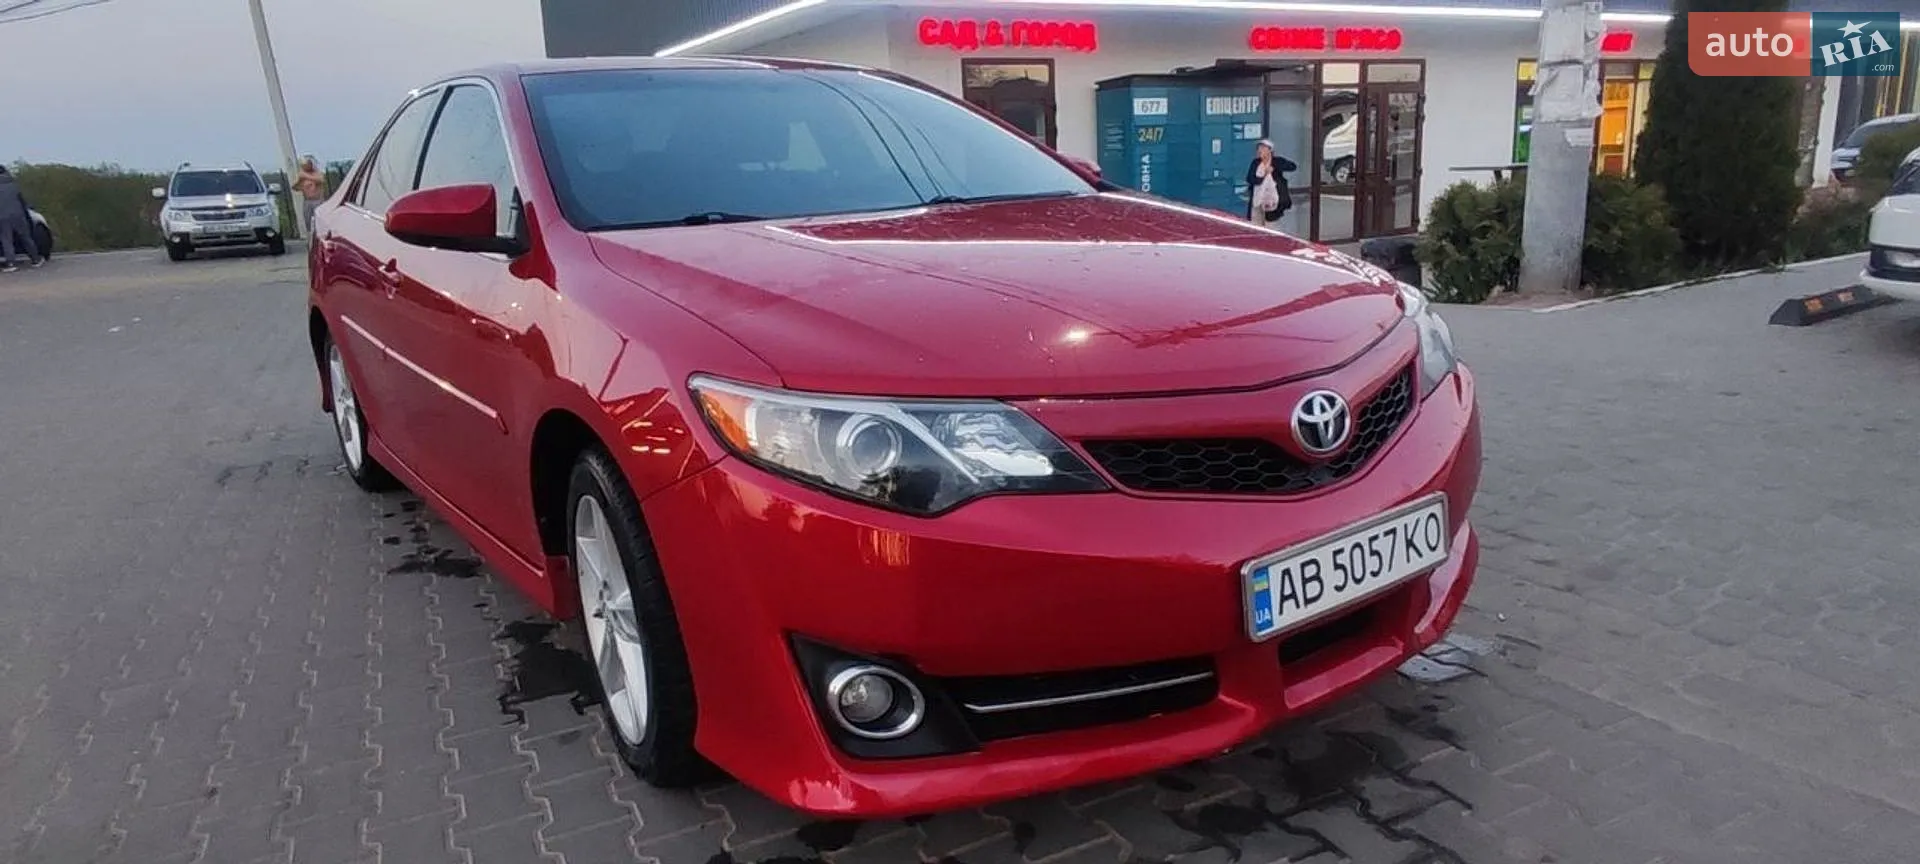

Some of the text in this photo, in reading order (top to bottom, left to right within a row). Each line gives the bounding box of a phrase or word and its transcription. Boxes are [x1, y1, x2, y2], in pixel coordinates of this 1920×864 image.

[919, 19, 1097, 51] САД & ГОРОД
[1141, 101, 1161, 113] 677
[1138, 127, 1164, 143] 24/7
[1278, 512, 1441, 615] AB 5057 KO
[1255, 608, 1272, 624] UA
